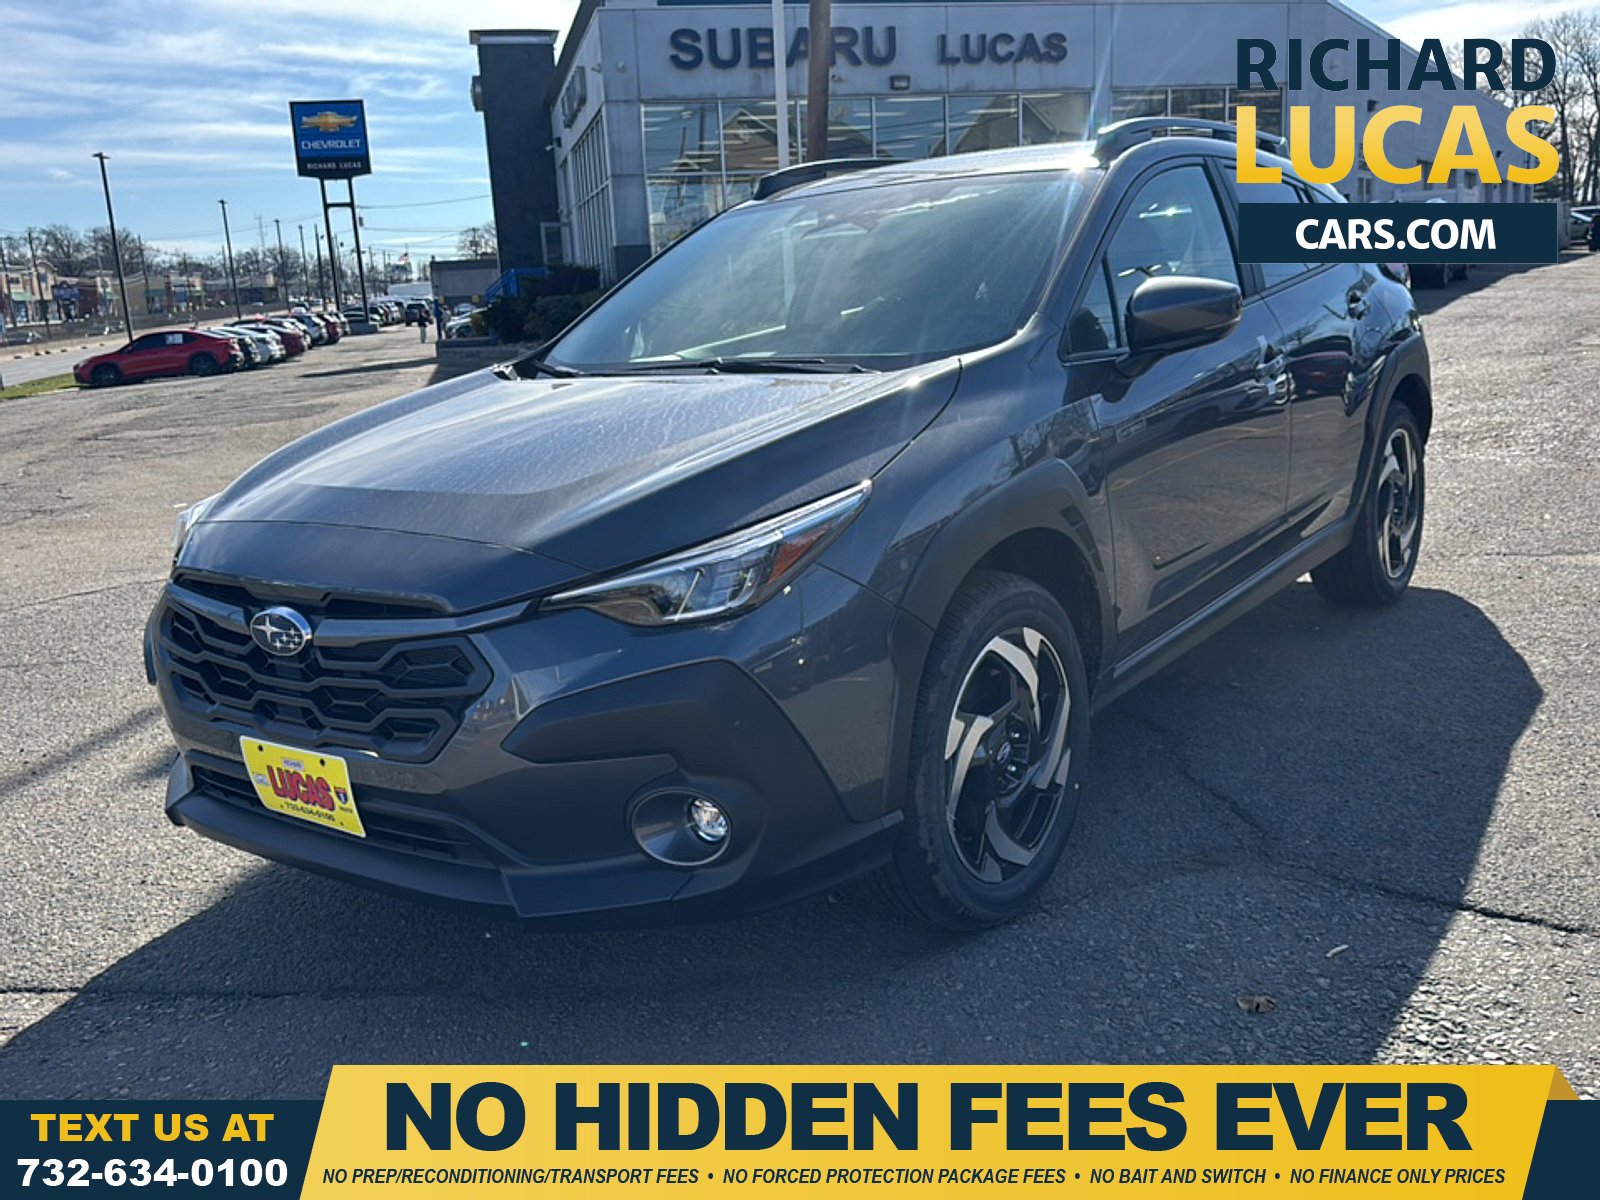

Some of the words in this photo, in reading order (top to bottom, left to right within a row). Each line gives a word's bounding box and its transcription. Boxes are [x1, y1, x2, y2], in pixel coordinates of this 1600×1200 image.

[669, 25, 896, 71] SUBARU
[937, 32, 1068, 66] LUCAS
[301, 138, 361, 150] CHEVROLET
[266, 764, 336, 812] LUCAS
